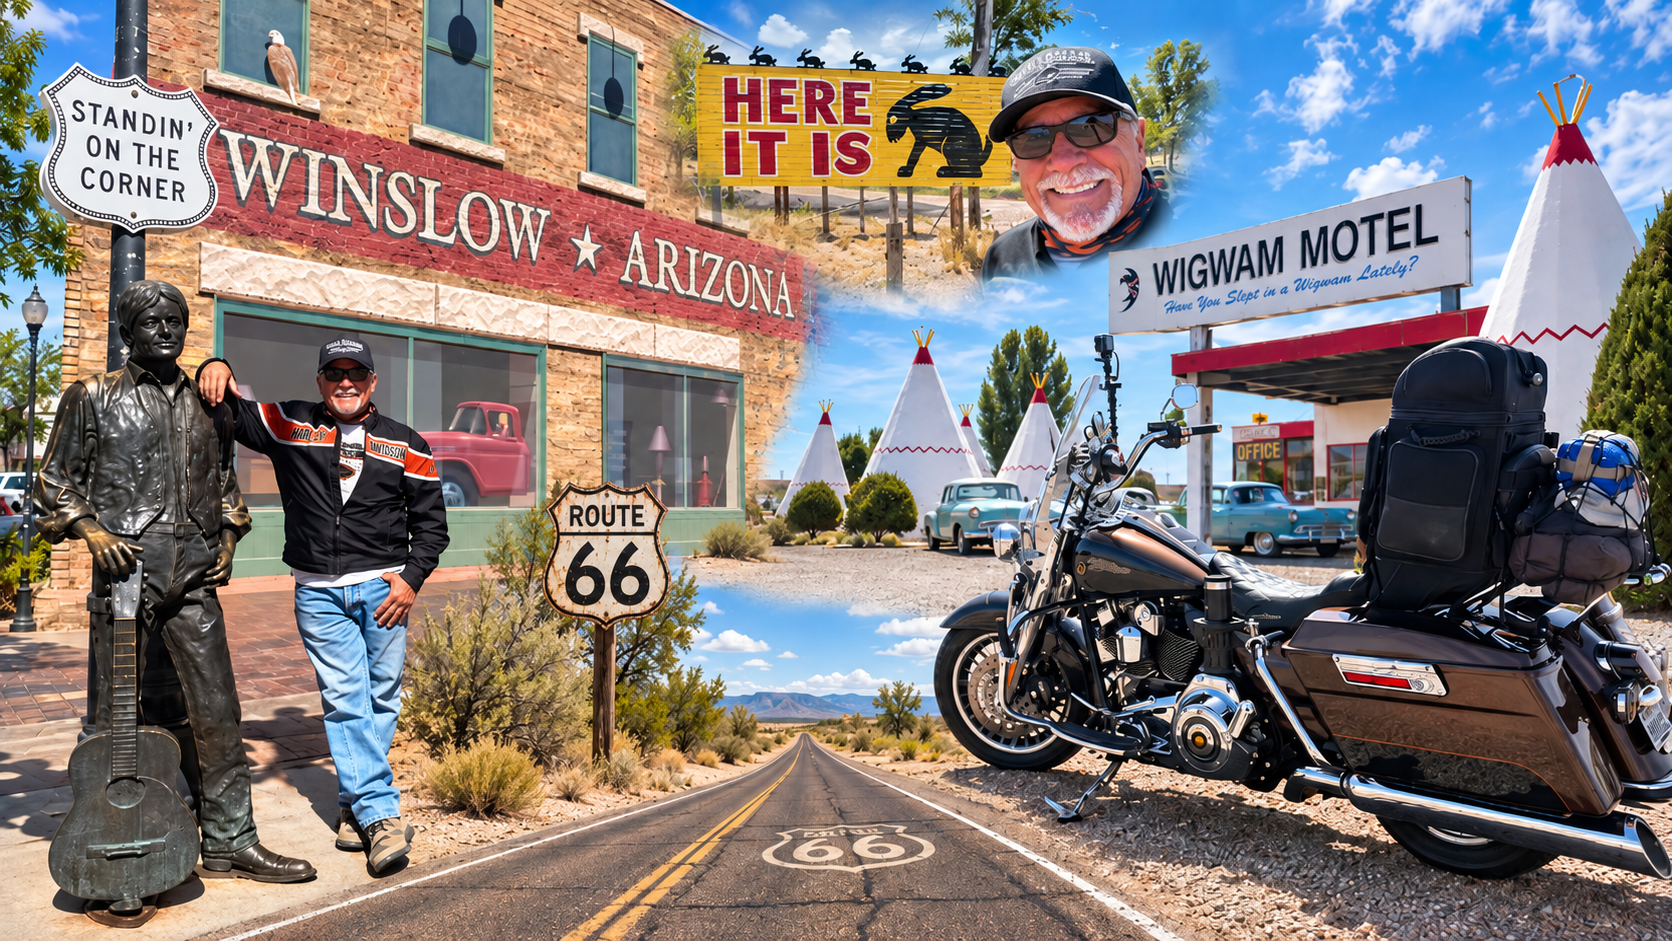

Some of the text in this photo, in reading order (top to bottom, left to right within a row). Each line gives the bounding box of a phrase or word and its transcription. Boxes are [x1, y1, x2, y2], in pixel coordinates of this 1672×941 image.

[71, 99, 193, 141] STANDIN'
[722, 75, 873, 127] HERE
[86, 134, 180, 171] ON THE
[722, 128, 873, 177] IT IS
[80, 166, 186, 203] CORNER
[218, 129, 796, 321] WINSLOW ARIZONA
[1152, 203, 1439, 297] WIGWAM MOTEL
[1163, 254, 1420, 314] Have You Slept in a Wigwam Lately?
[1237, 441, 1281, 461] OFFICE
[569, 504, 645, 527] ROUTE
[565, 541, 650, 606] 66
[793, 835, 905, 862] 66
